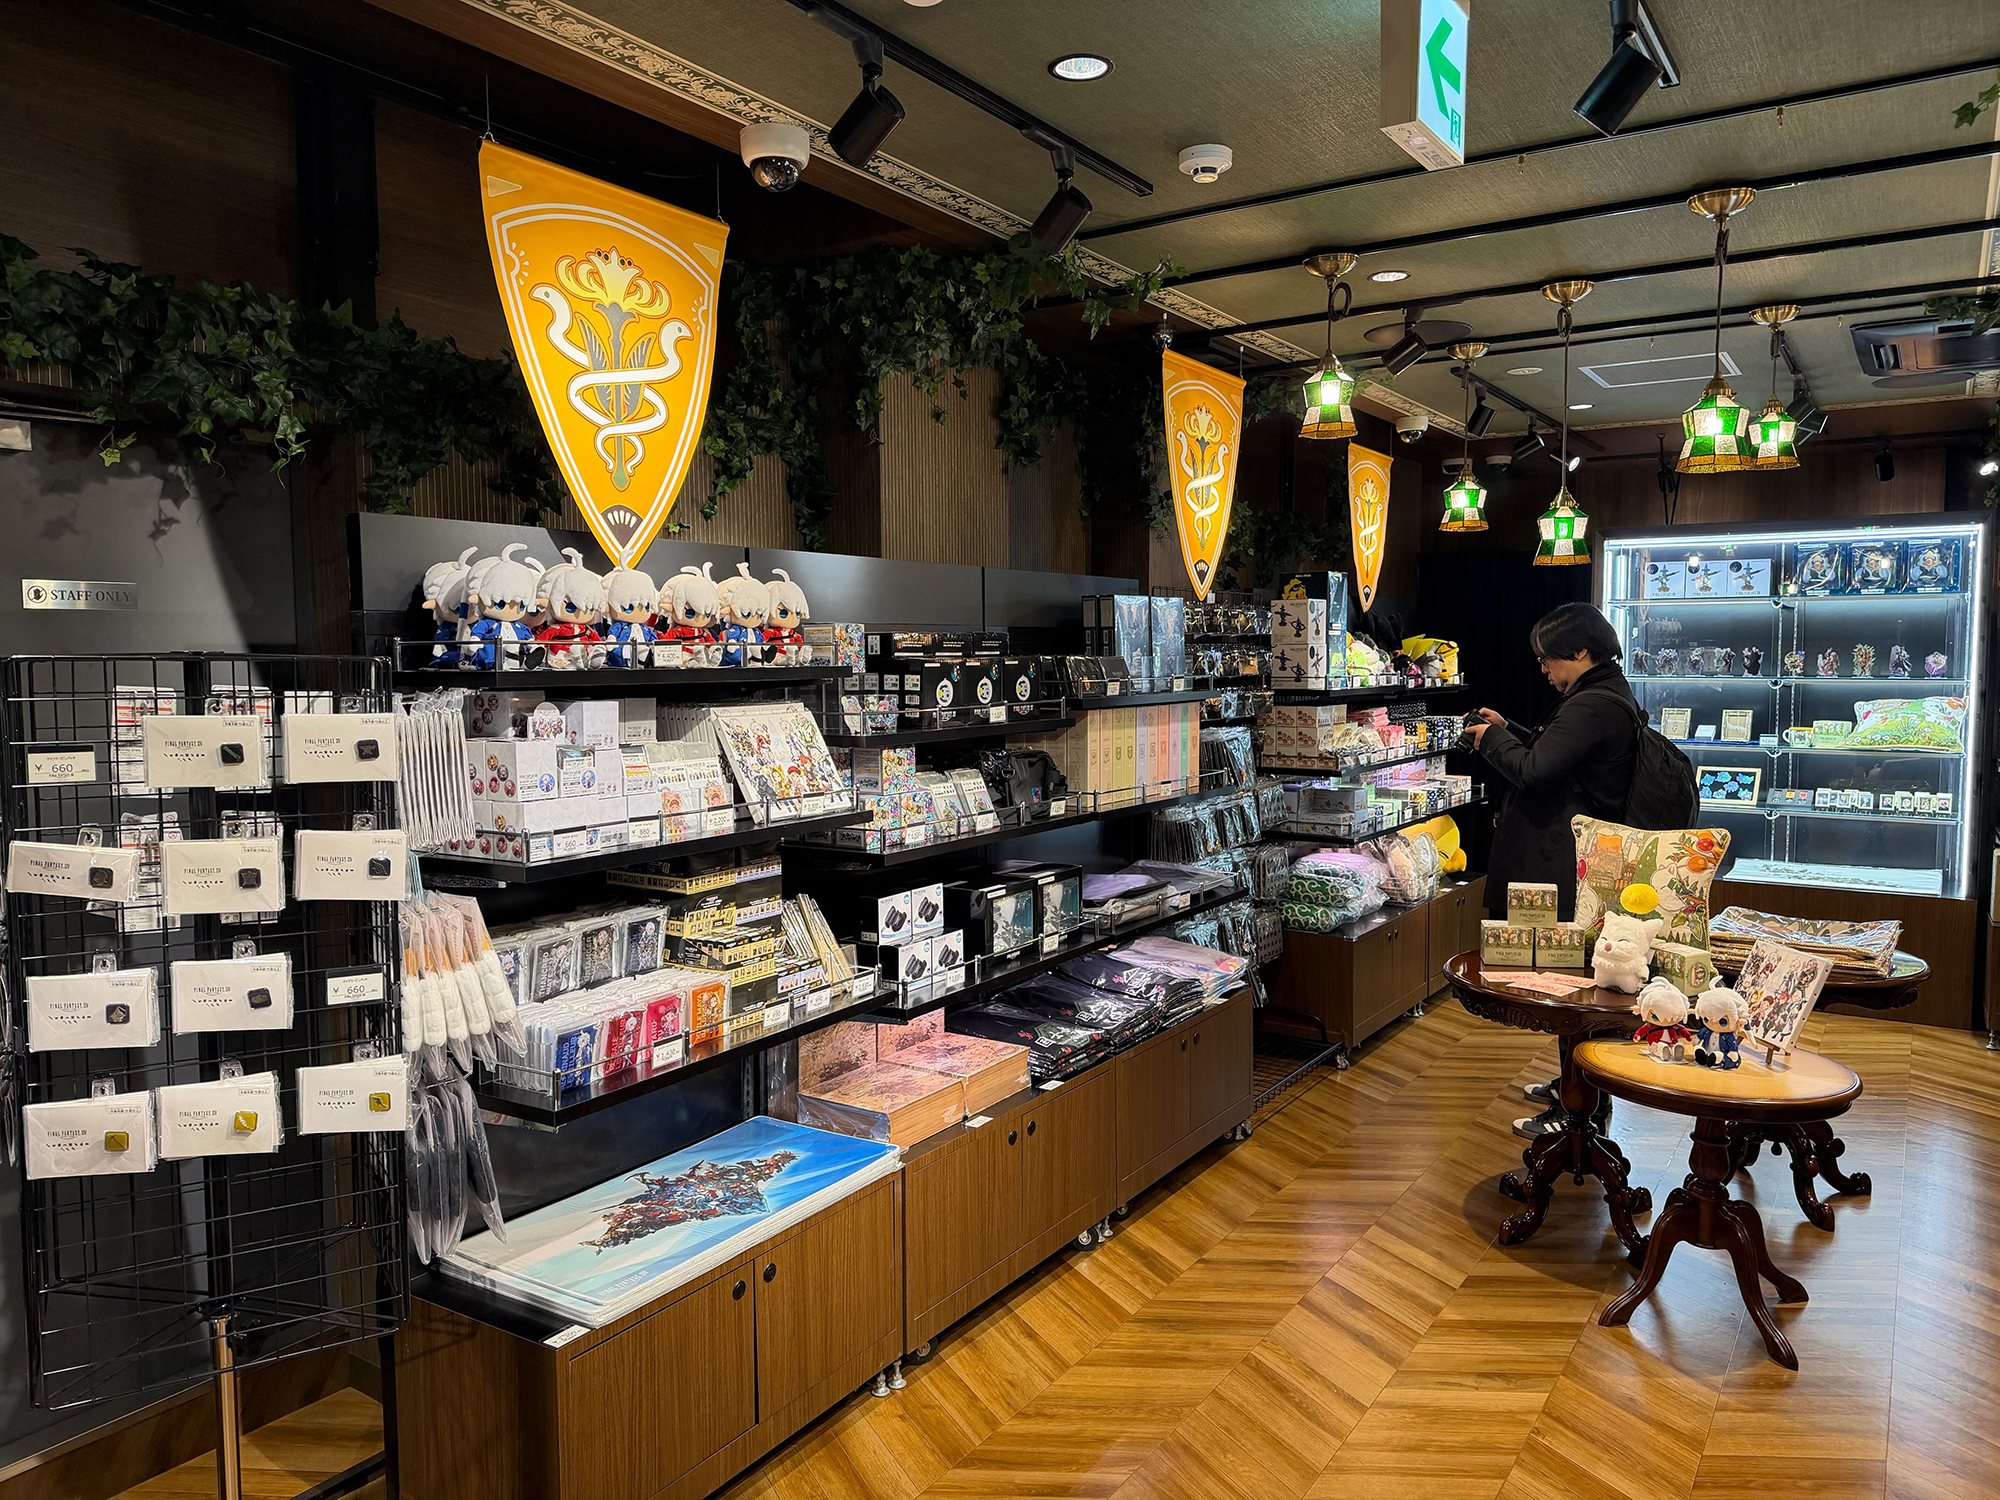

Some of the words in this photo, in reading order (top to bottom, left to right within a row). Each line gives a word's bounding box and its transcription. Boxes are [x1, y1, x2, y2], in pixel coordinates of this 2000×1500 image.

[50, 590, 92, 601] STAFF
[95, 591, 132, 602] ONLY
[51, 763, 74, 773] 660
[564, 840, 577, 848] 660
[346, 985, 366, 995] 660
